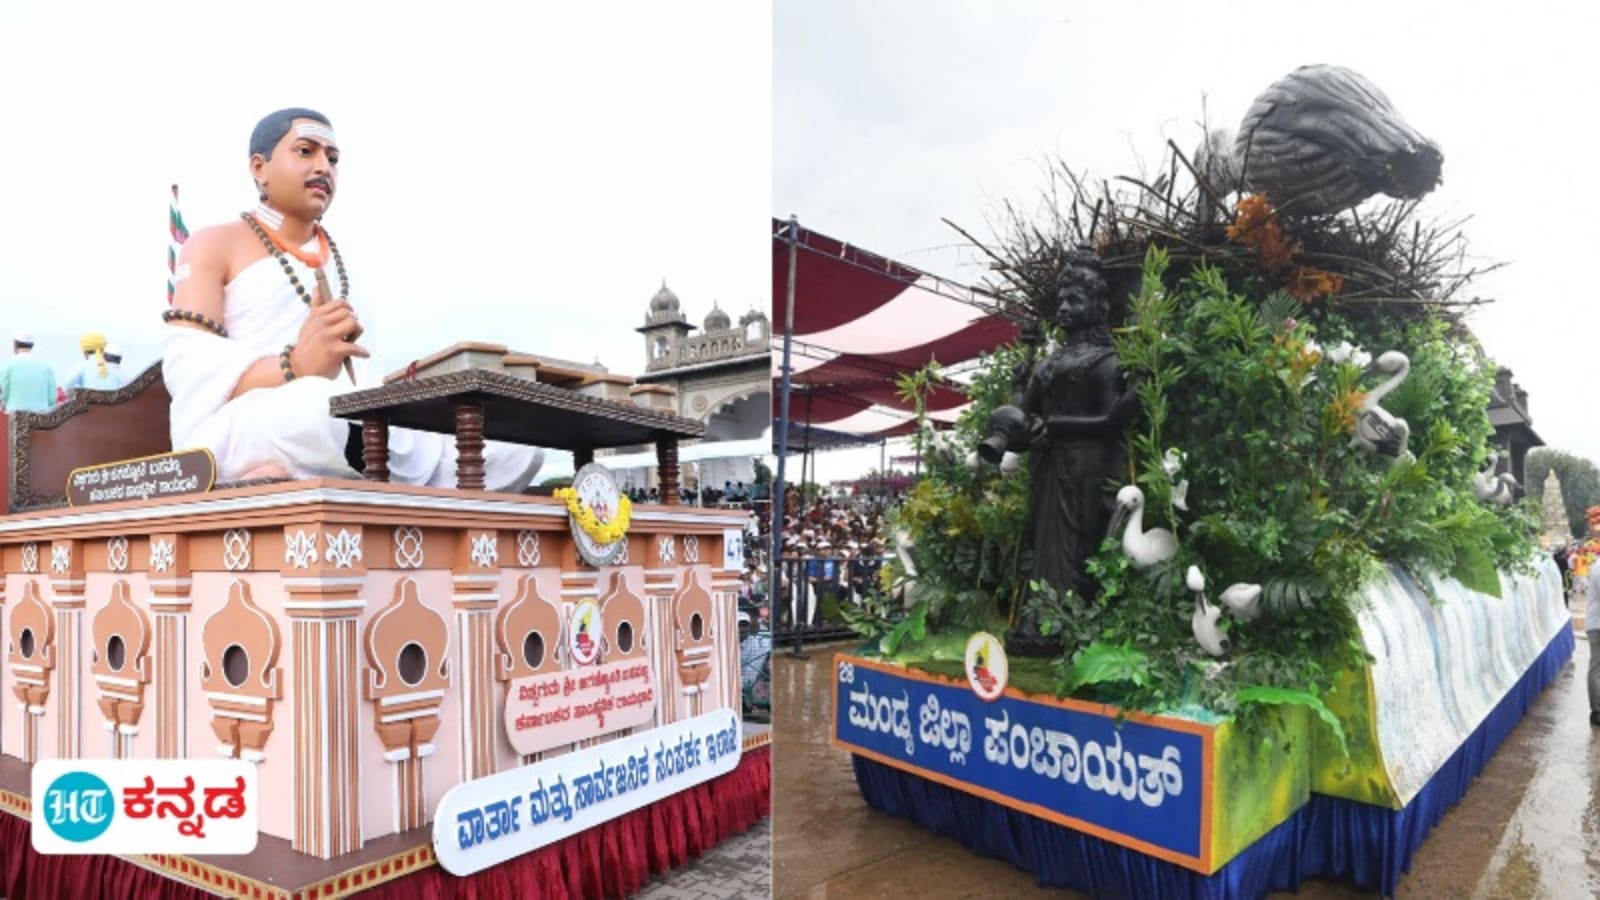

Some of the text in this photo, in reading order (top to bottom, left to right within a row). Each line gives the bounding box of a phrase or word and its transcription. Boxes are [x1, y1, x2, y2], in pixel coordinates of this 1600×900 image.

[457, 716, 737, 851] ವಾರ್ತಾ ಮತ್ತು ಸಾರ್ವಜನಿಕ ಸಂಪರ್ಕ ಇಲಾಖೆ
[848, 681, 1184, 808] ಮಂಡ್ಯ ಜಿಲ್ಲಾ ಪಂಚಾಯತ್
